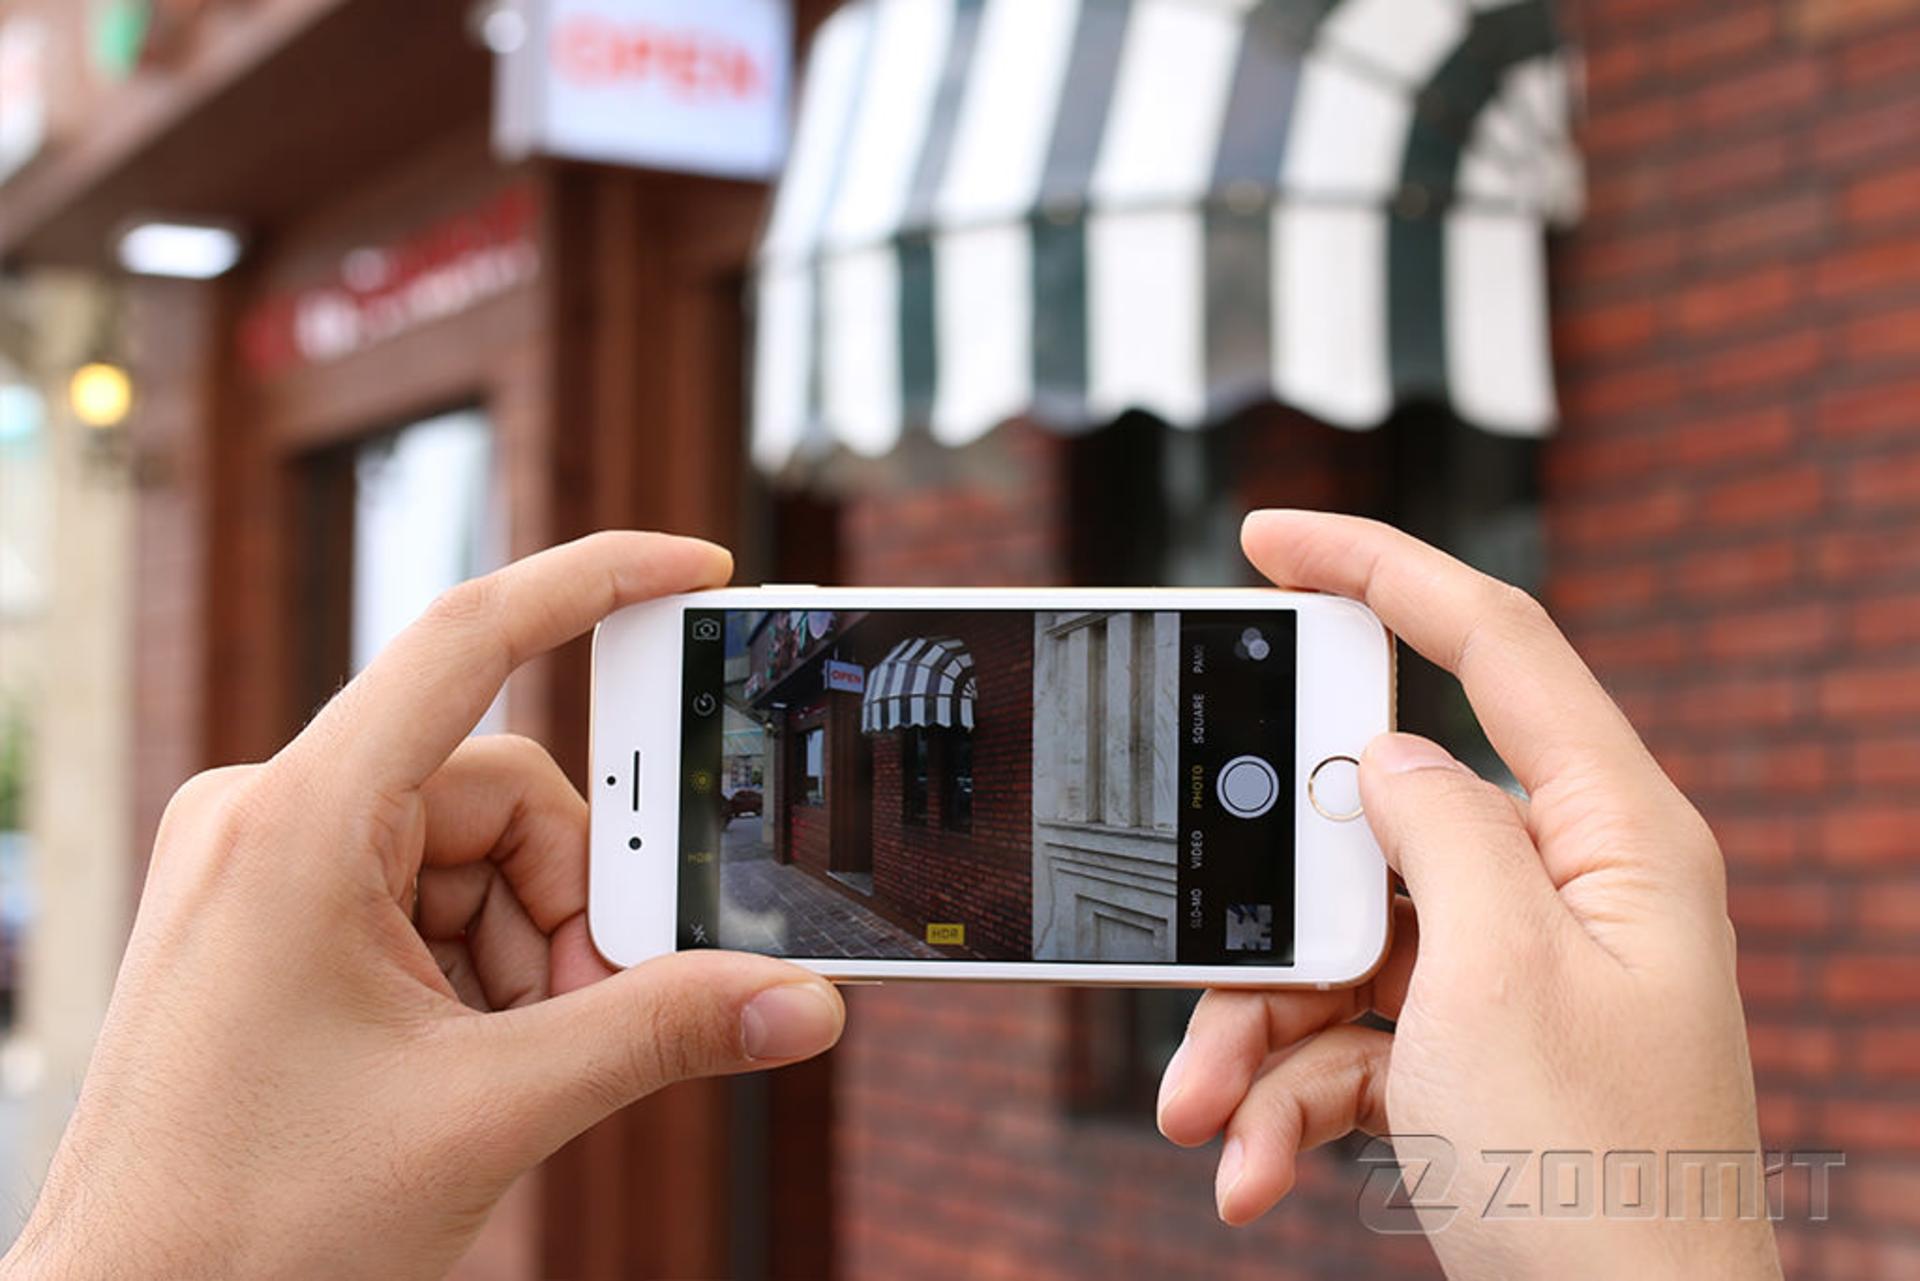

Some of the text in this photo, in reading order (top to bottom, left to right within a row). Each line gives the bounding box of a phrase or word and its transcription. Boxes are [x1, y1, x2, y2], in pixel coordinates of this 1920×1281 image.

[552, 12, 765, 102] OPEN
[831, 669, 862, 685] OPEN
[1191, 692, 1205, 744] SQUARE
[1190, 763, 1204, 809] PHOTO
[1190, 829, 1204, 870] VIDEO
[930, 926, 960, 941] HDR
